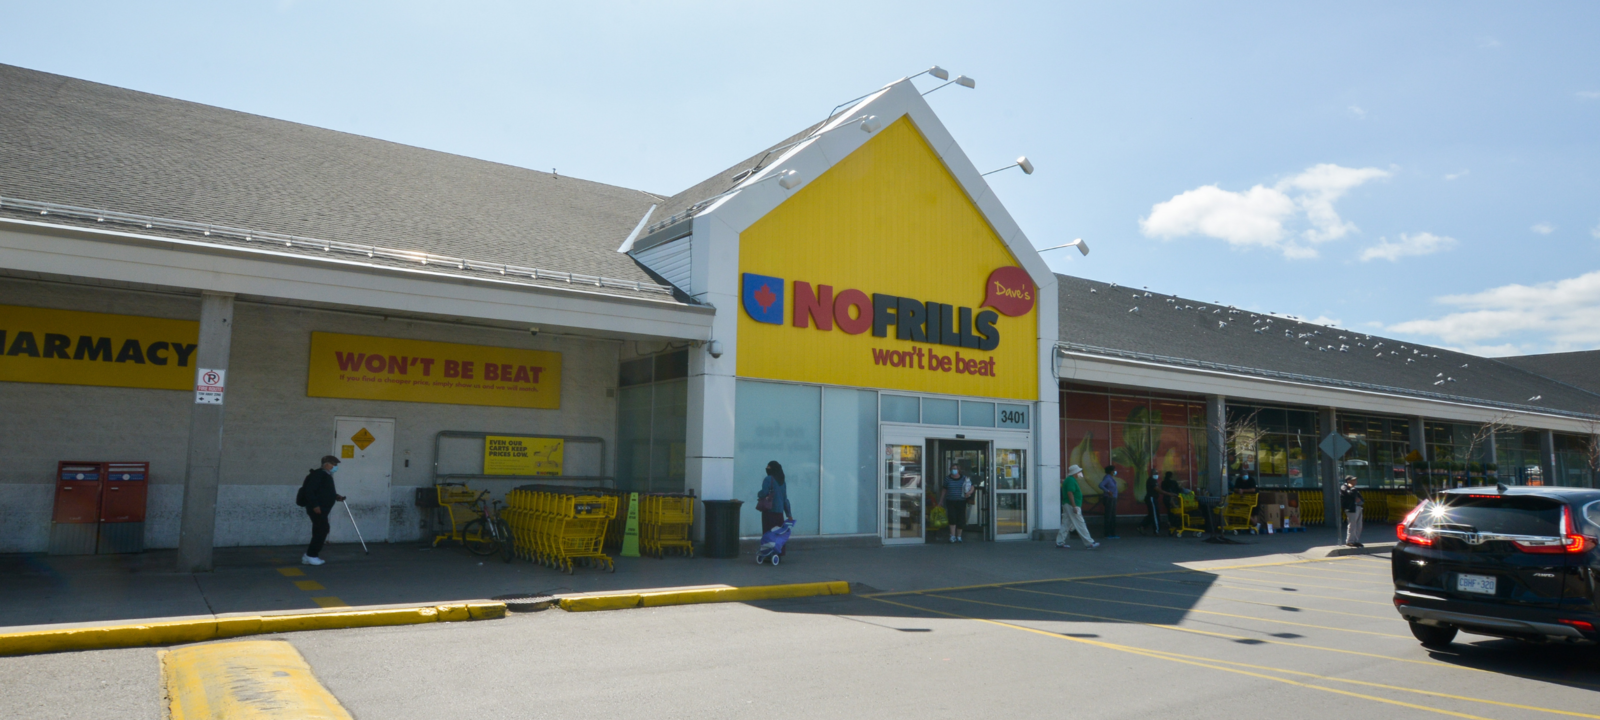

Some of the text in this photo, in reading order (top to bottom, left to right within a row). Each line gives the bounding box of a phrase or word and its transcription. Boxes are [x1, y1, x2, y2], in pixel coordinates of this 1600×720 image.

[994, 280, 1031, 300] Dave's
[0, 330, 197, 367] ARMACY
[335, 351, 543, 384] WON'T BE BEAT
[872, 346, 996, 377] won't be beat
[362, 375, 376, 383] find
[384, 377, 411, 386] cheaper
[1001, 410, 1025, 424] 3401
